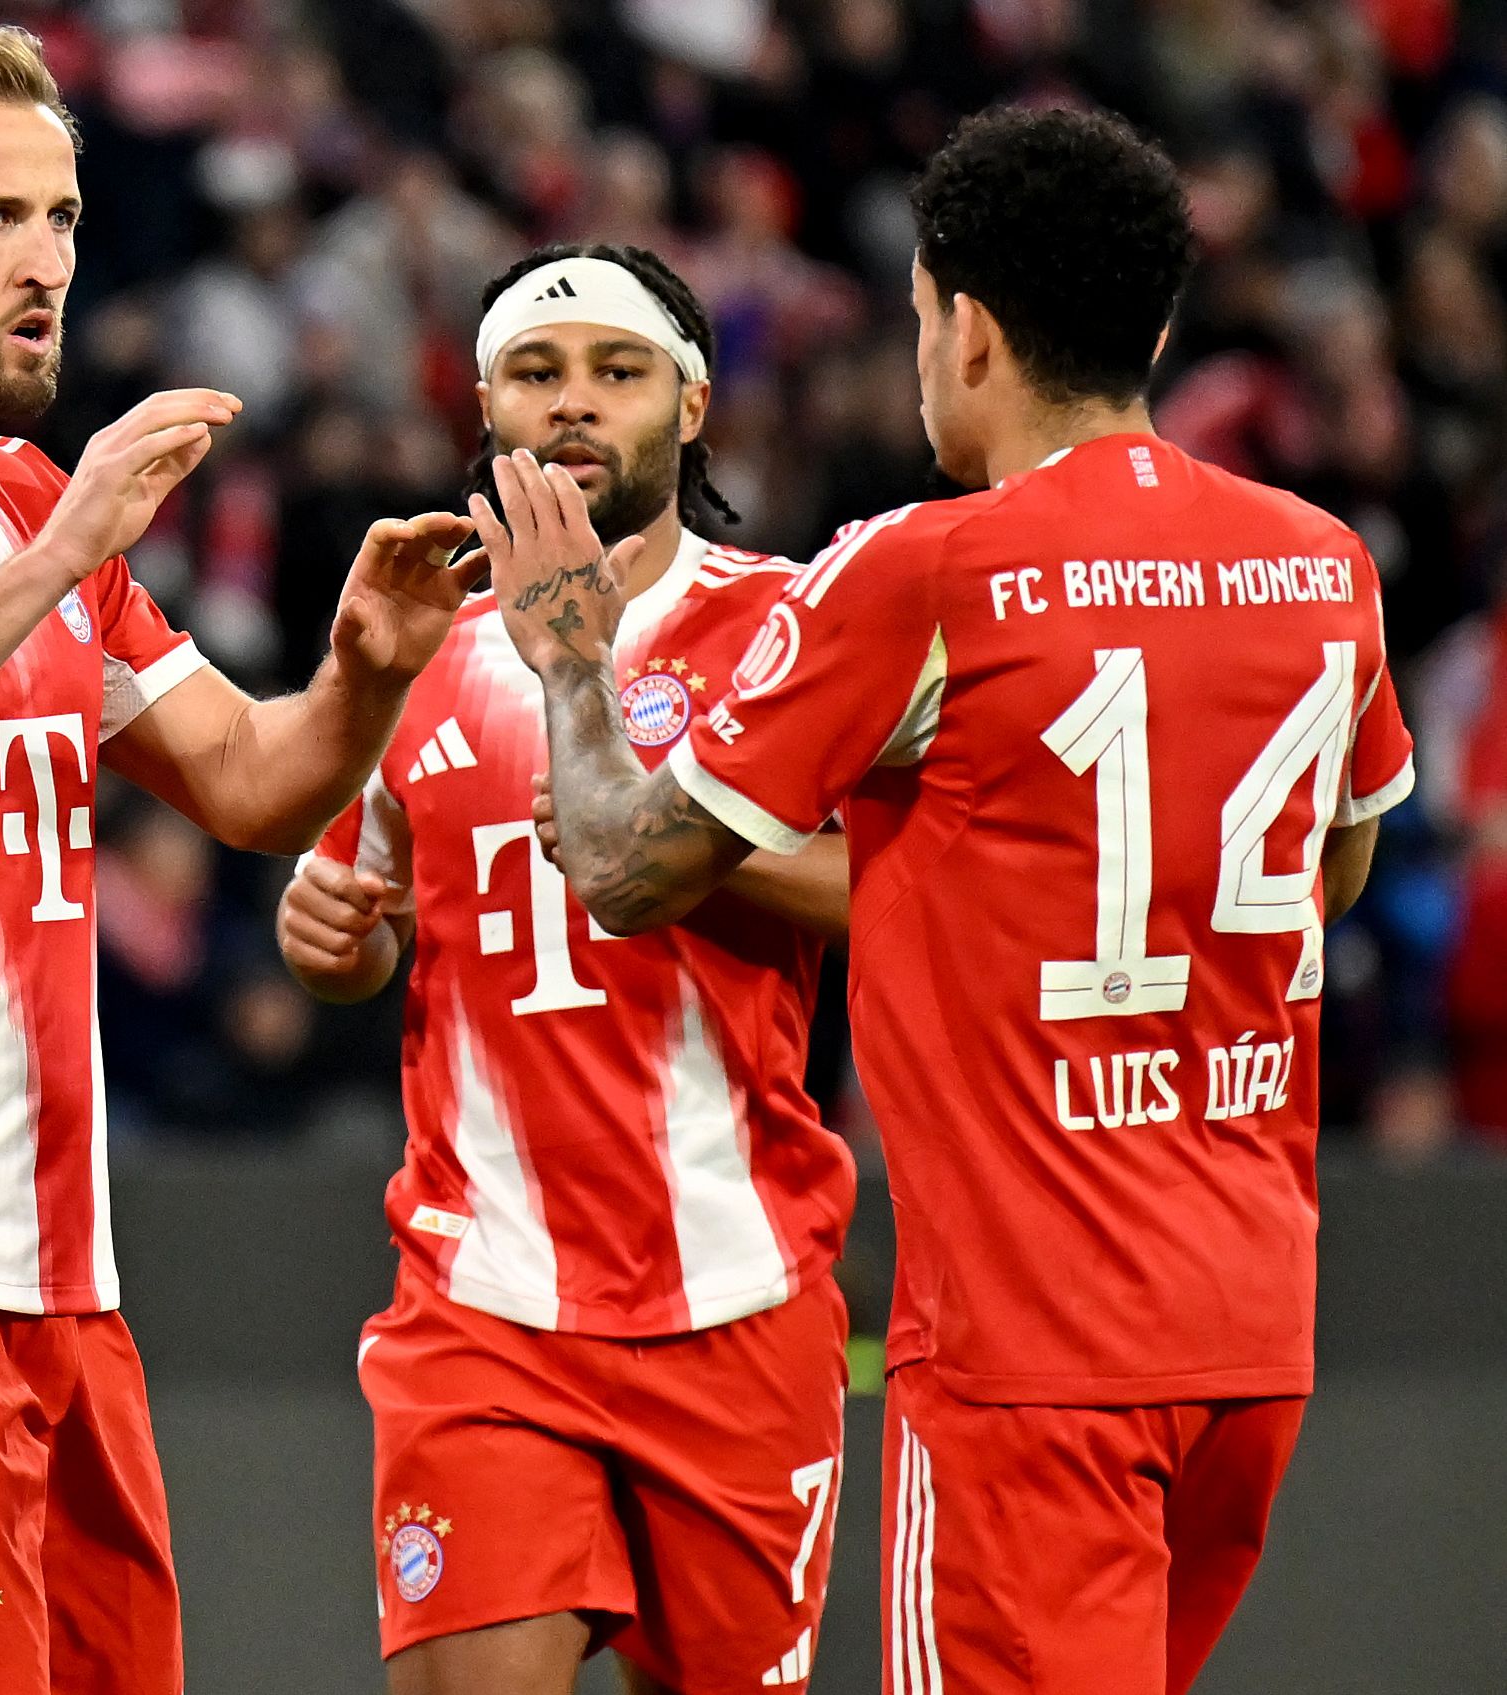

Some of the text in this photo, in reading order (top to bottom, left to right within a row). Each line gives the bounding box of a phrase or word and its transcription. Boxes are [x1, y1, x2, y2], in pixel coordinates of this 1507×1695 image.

[990, 555, 1354, 621] FC BAYERN MÜNCHEN
[707, 700, 755, 746] nz
[1040, 641, 1357, 1021] 14
[1054, 1030, 1294, 1131] LUIS DÍAZ
[790, 1456, 836, 1604] 7
